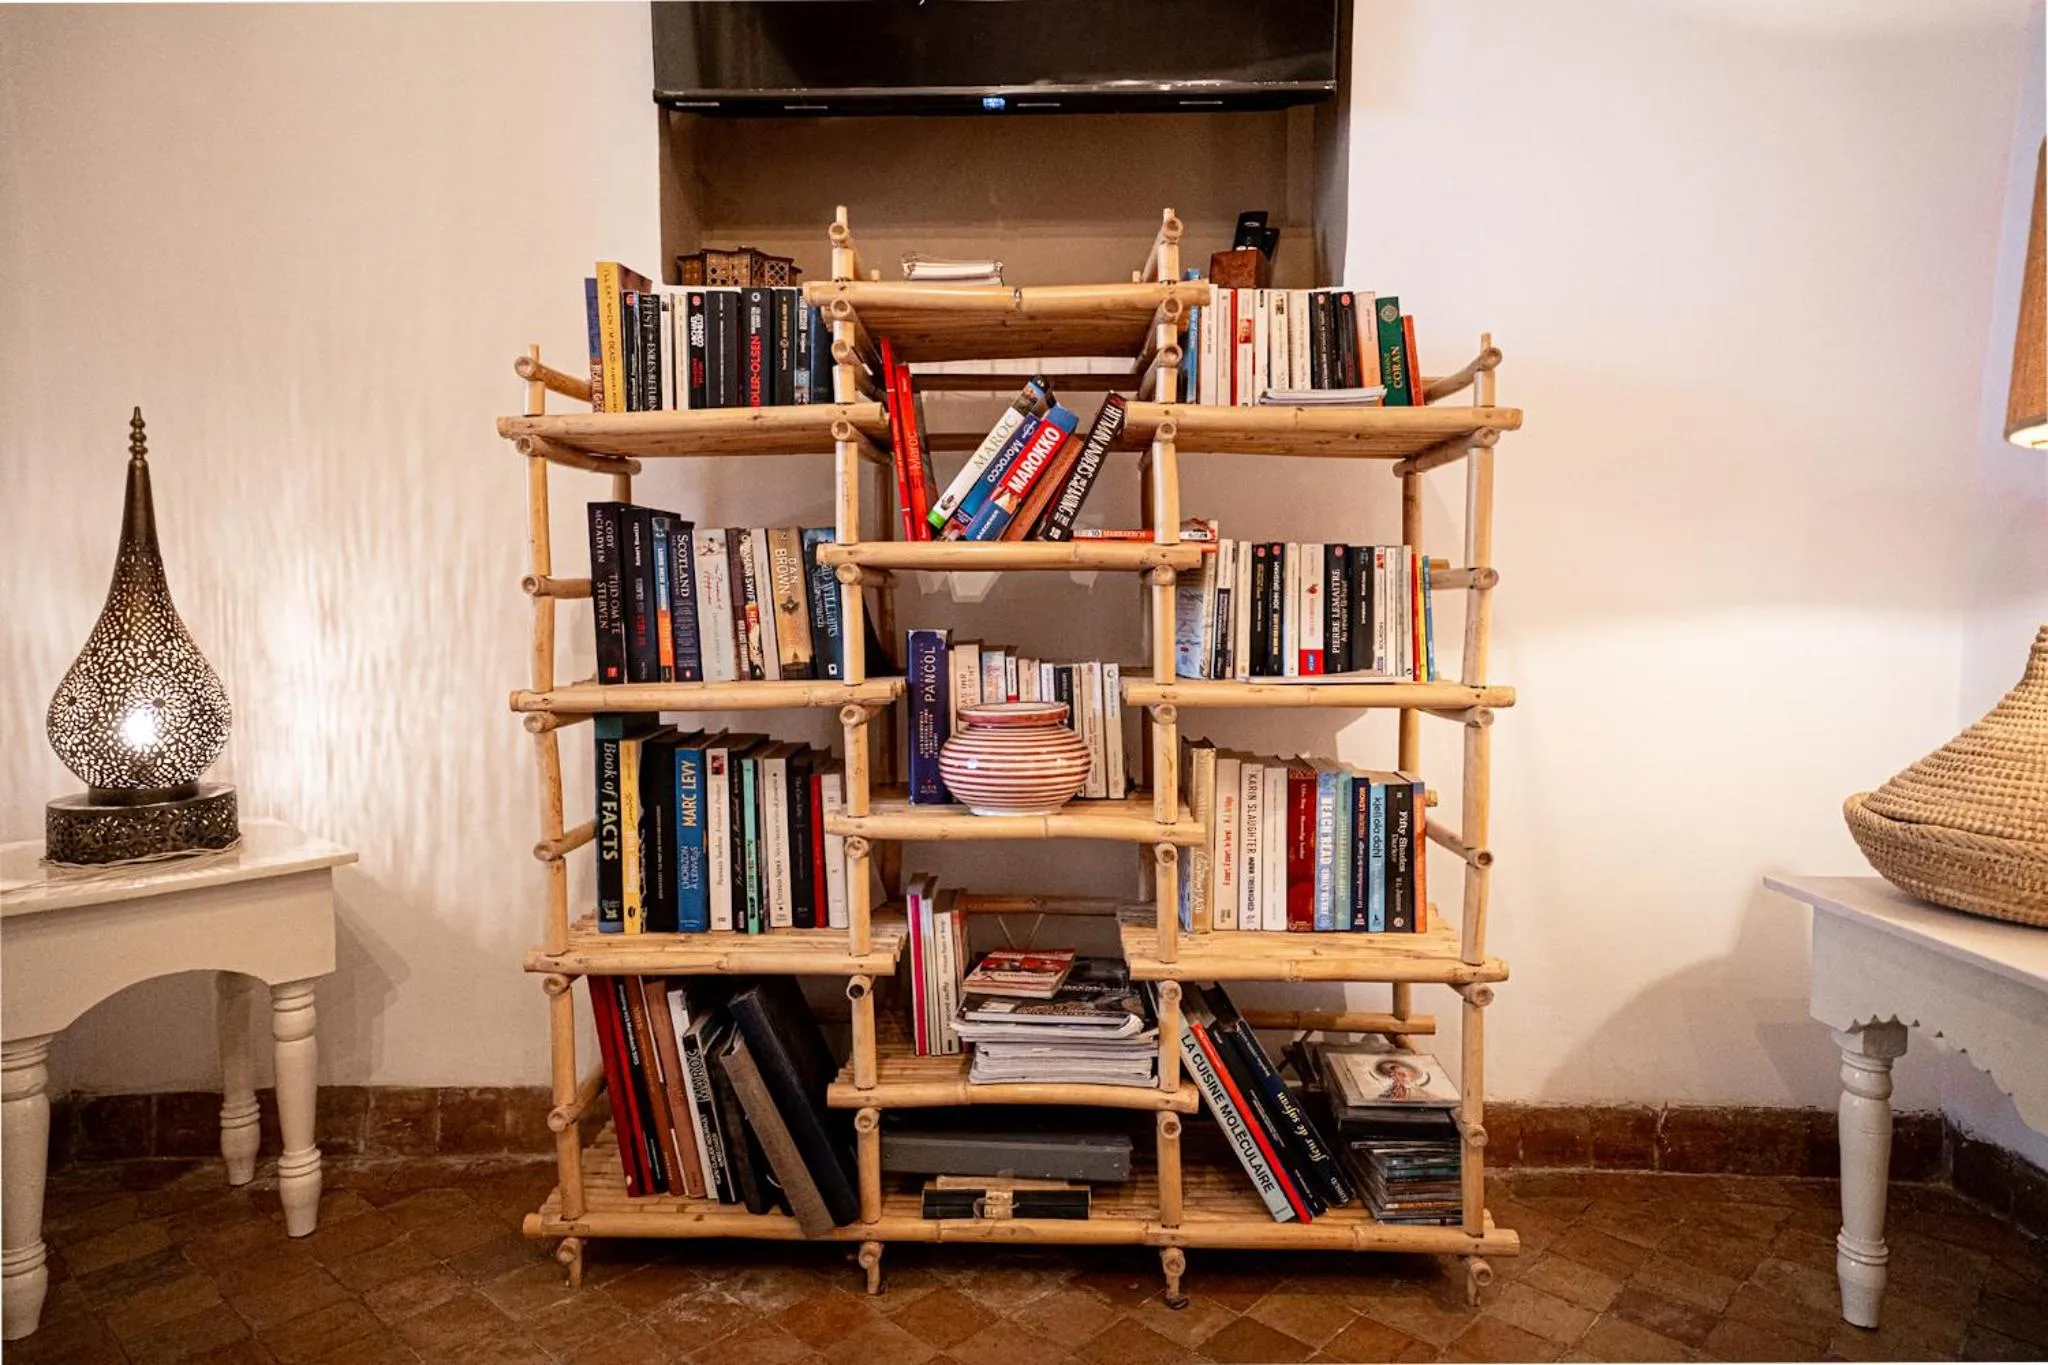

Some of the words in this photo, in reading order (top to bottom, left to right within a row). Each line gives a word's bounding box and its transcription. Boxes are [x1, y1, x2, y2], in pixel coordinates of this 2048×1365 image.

[1390, 346, 1403, 389] CORAN
[973, 415, 1019, 471] MAROC
[1091, 403, 1123, 447] HITMAN
[906, 430, 922, 470] Maroc
[986, 439, 1025, 483] Morocco
[1007, 426, 1061, 494] MAROKKO
[1076, 440, 1104, 480] ANDERS
[594, 510, 606, 563] MCFADYEN
[604, 520, 616, 550] CODY
[677, 534, 691, 598] SCOTLAND
[740, 535, 753, 577] GRAHAM
[775, 549, 790, 594] BROWN
[787, 557, 799, 584] DAN
[608, 573, 620, 599] TIJD
[744, 578, 756, 604] SWIFT
[1332, 568, 1341, 618] LEMAITRE
[596, 582, 610, 630] STERVEN
[610, 600, 620, 621] OM
[611, 621, 621, 635] TE
[1332, 619, 1341, 654] PIERRE
[923, 645, 937, 703] PANCOL
[602, 742, 617, 778] Book
[681, 759, 697, 789] LEVY
[601, 781, 619, 798] of
[1246, 773, 1257, 801] KARIN
[681, 793, 697, 827] MARC
[1246, 803, 1257, 854] SLAUGHTER
[1319, 797, 1332, 834] BEACH
[1397, 810, 1409, 836] Fifty
[602, 801, 619, 860] FACTS
[1371, 835, 1383, 858] dahl
[1390, 833, 1399, 864] Darker
[681, 844, 690, 889] L'HORIZON
[1319, 837, 1332, 865] READ
[1397, 836, 1408, 873] Shades
[1395, 889, 1403, 912] James
[685, 1049, 710, 1103] MAROC
[1181, 1033, 1196, 1053] LA
[1191, 1051, 1224, 1107] CUISINE
[1276, 1091, 1303, 1126] safran
[1296, 1122, 1309, 1139] de
[1304, 1136, 1329, 1163] fleur
